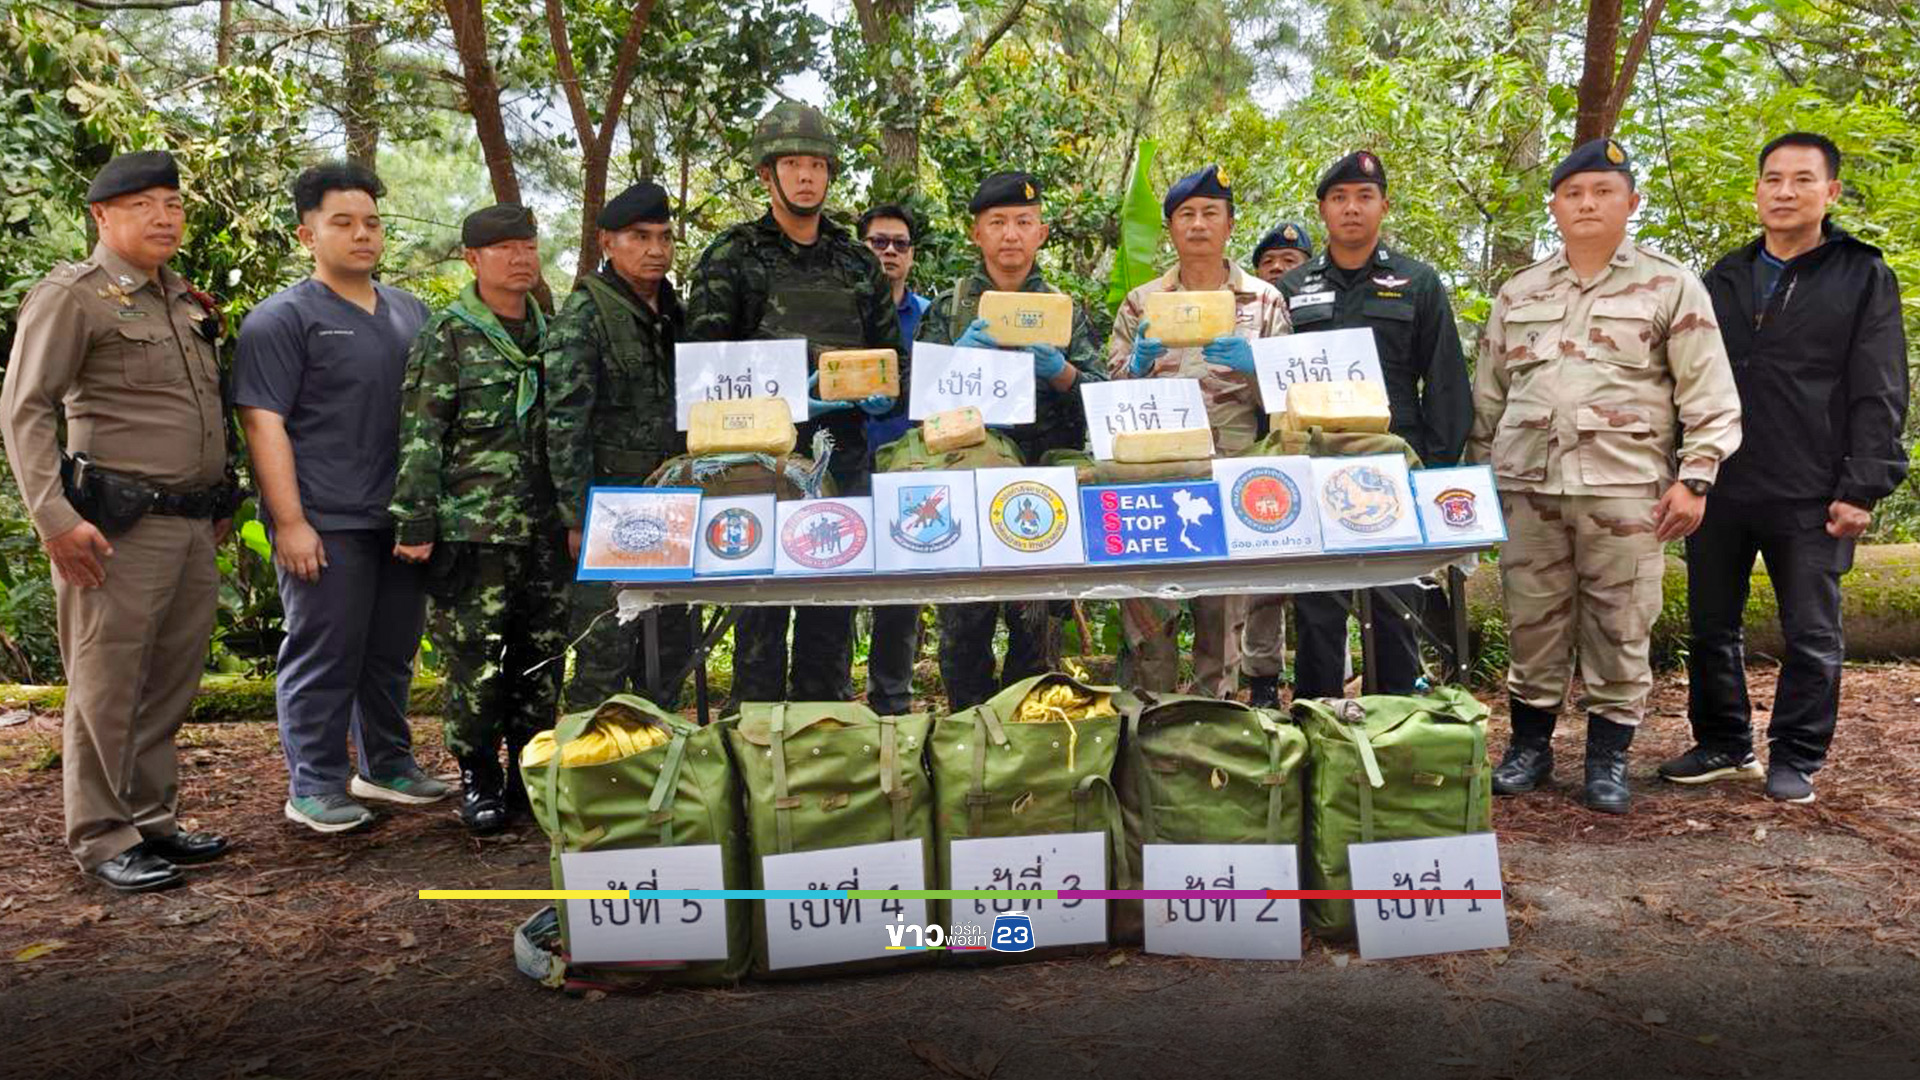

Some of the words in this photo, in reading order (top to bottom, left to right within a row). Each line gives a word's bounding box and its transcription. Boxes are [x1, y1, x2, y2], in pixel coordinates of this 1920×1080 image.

[706, 367, 752, 402] เป้ที่
[765, 380, 779, 397] 9
[938, 367, 982, 397] เป้ที่
[993, 379, 1008, 398] 8
[1275, 348, 1332, 391] เป้ที่
[1347, 360, 1365, 381] 6
[1105, 394, 1161, 435] เป้ที่
[1172, 408, 1190, 429] 7
[1100, 490, 1163, 512] SEAL
[1103, 512, 1166, 533] STOP
[1105, 533, 1169, 555] SAFE
[590, 869, 660, 926] เป้ที่
[681, 888, 703, 924] 5
[789, 867, 861, 930] เป้ที่
[881, 884, 905, 919] 4
[974, 855, 1043, 915] เป้ที่
[1062, 874, 1083, 909] 3
[1167, 865, 1236, 922] เป้ที่
[1255, 887, 1279, 922] 2
[1376, 859, 1445, 921] เป้ที่
[1463, 878, 1482, 913] 1
